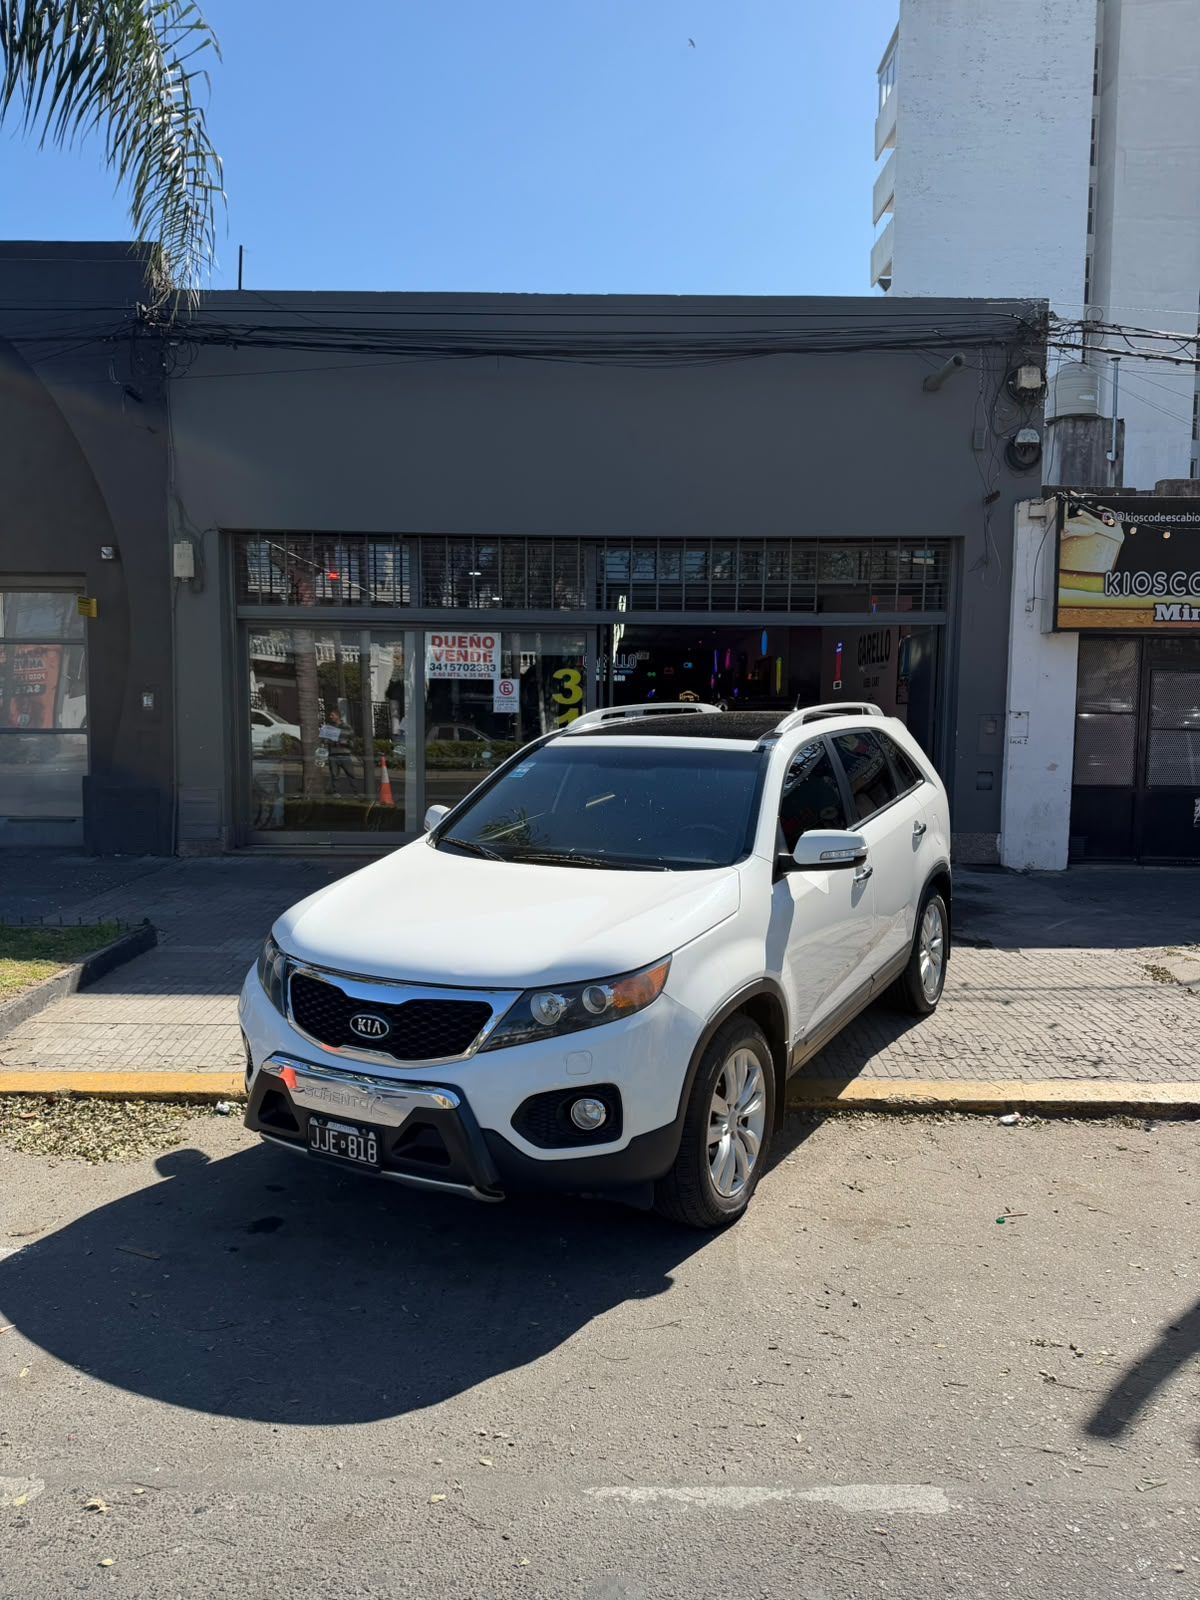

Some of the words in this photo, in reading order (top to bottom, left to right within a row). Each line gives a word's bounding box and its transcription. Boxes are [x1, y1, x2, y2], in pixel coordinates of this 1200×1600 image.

[431, 634, 495, 649] DUEÑO
[858, 630, 891, 666] CARELLO
[433, 650, 494, 663] VENDE
[357, 1018, 382, 1034] KIA
[304, 1086, 369, 1109] SORENTO
[311, 1127, 339, 1154] JJE
[348, 1135, 377, 1164] 818
